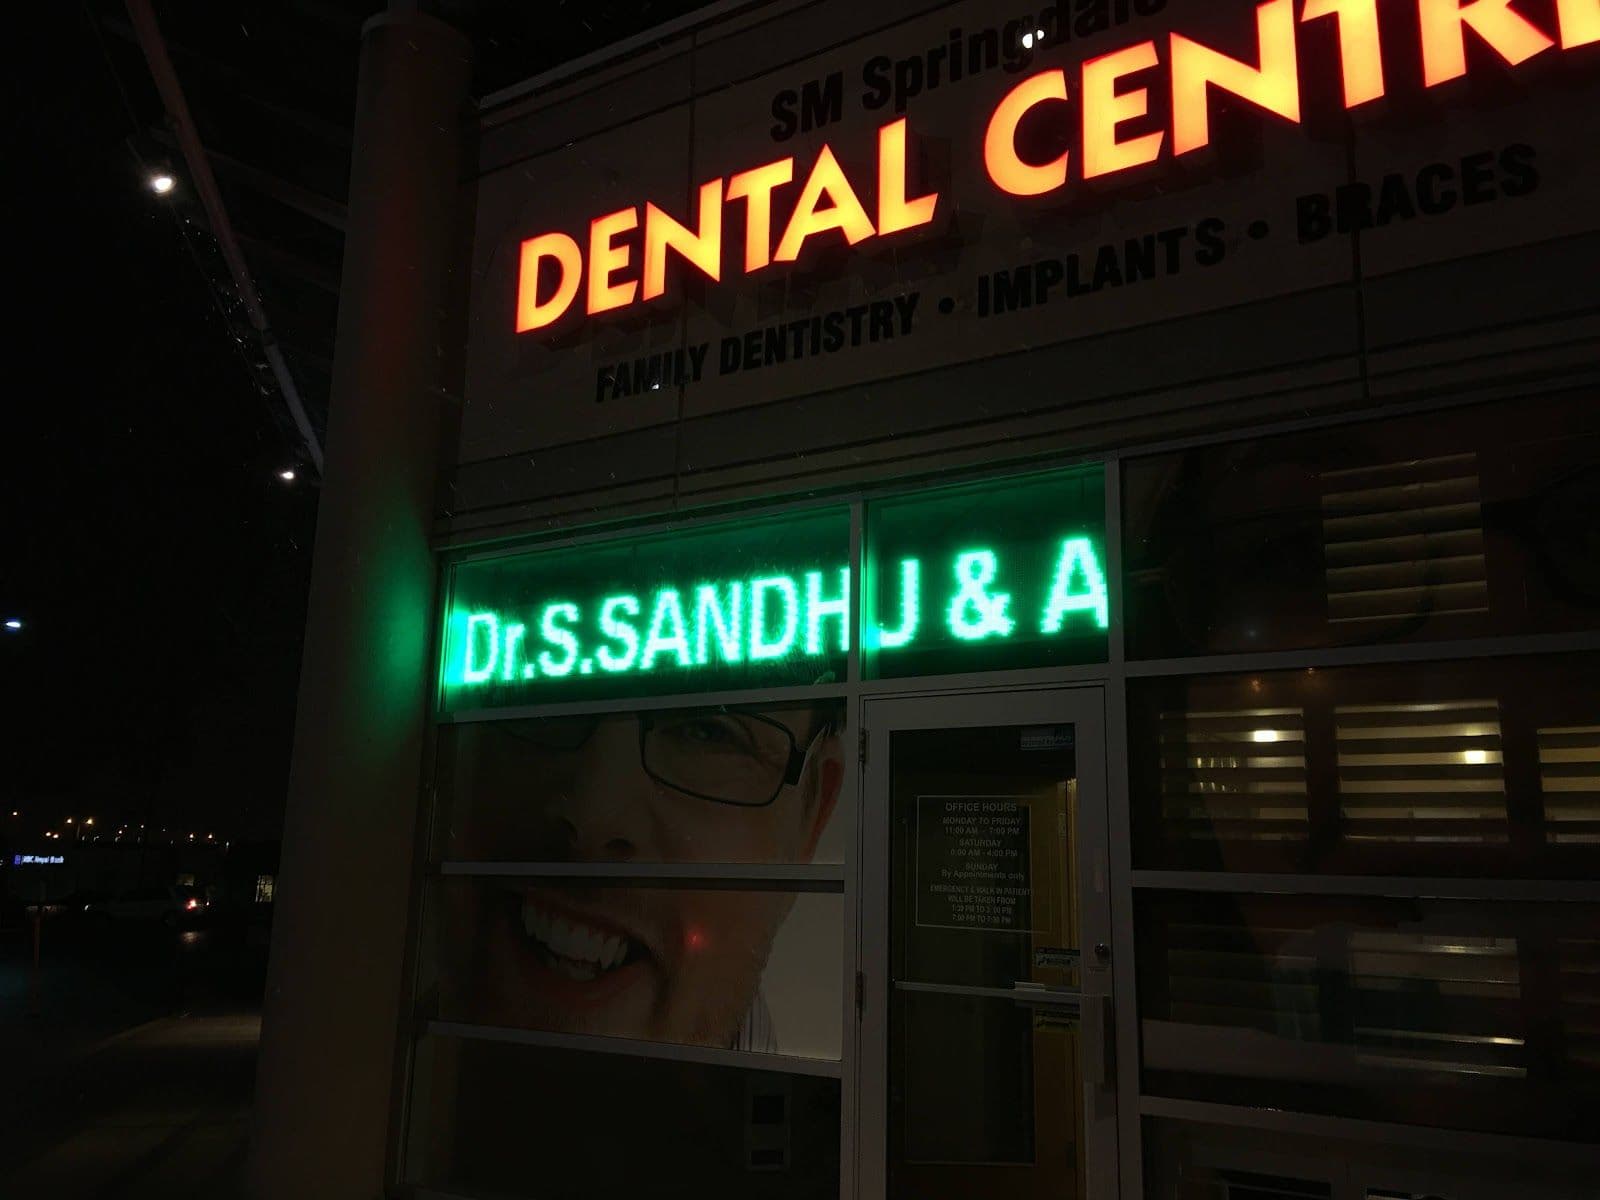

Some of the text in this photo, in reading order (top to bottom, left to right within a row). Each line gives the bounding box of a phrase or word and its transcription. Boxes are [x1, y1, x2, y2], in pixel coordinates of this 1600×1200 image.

[770, 72, 843, 142] SM
[516, 0, 1600, 334] DENTAL CENTR
[596, 143, 1538, 402] FAMILY DENTISTRY IMPLANTS BRACES
[946, 548, 1014, 641] &
[942, 816, 977, 825] MONDAY
[991, 816, 1021, 826] FRIDAY
[945, 802, 1017, 812] OFFICE HOURS
[958, 838, 1001, 848] SATURDAY
